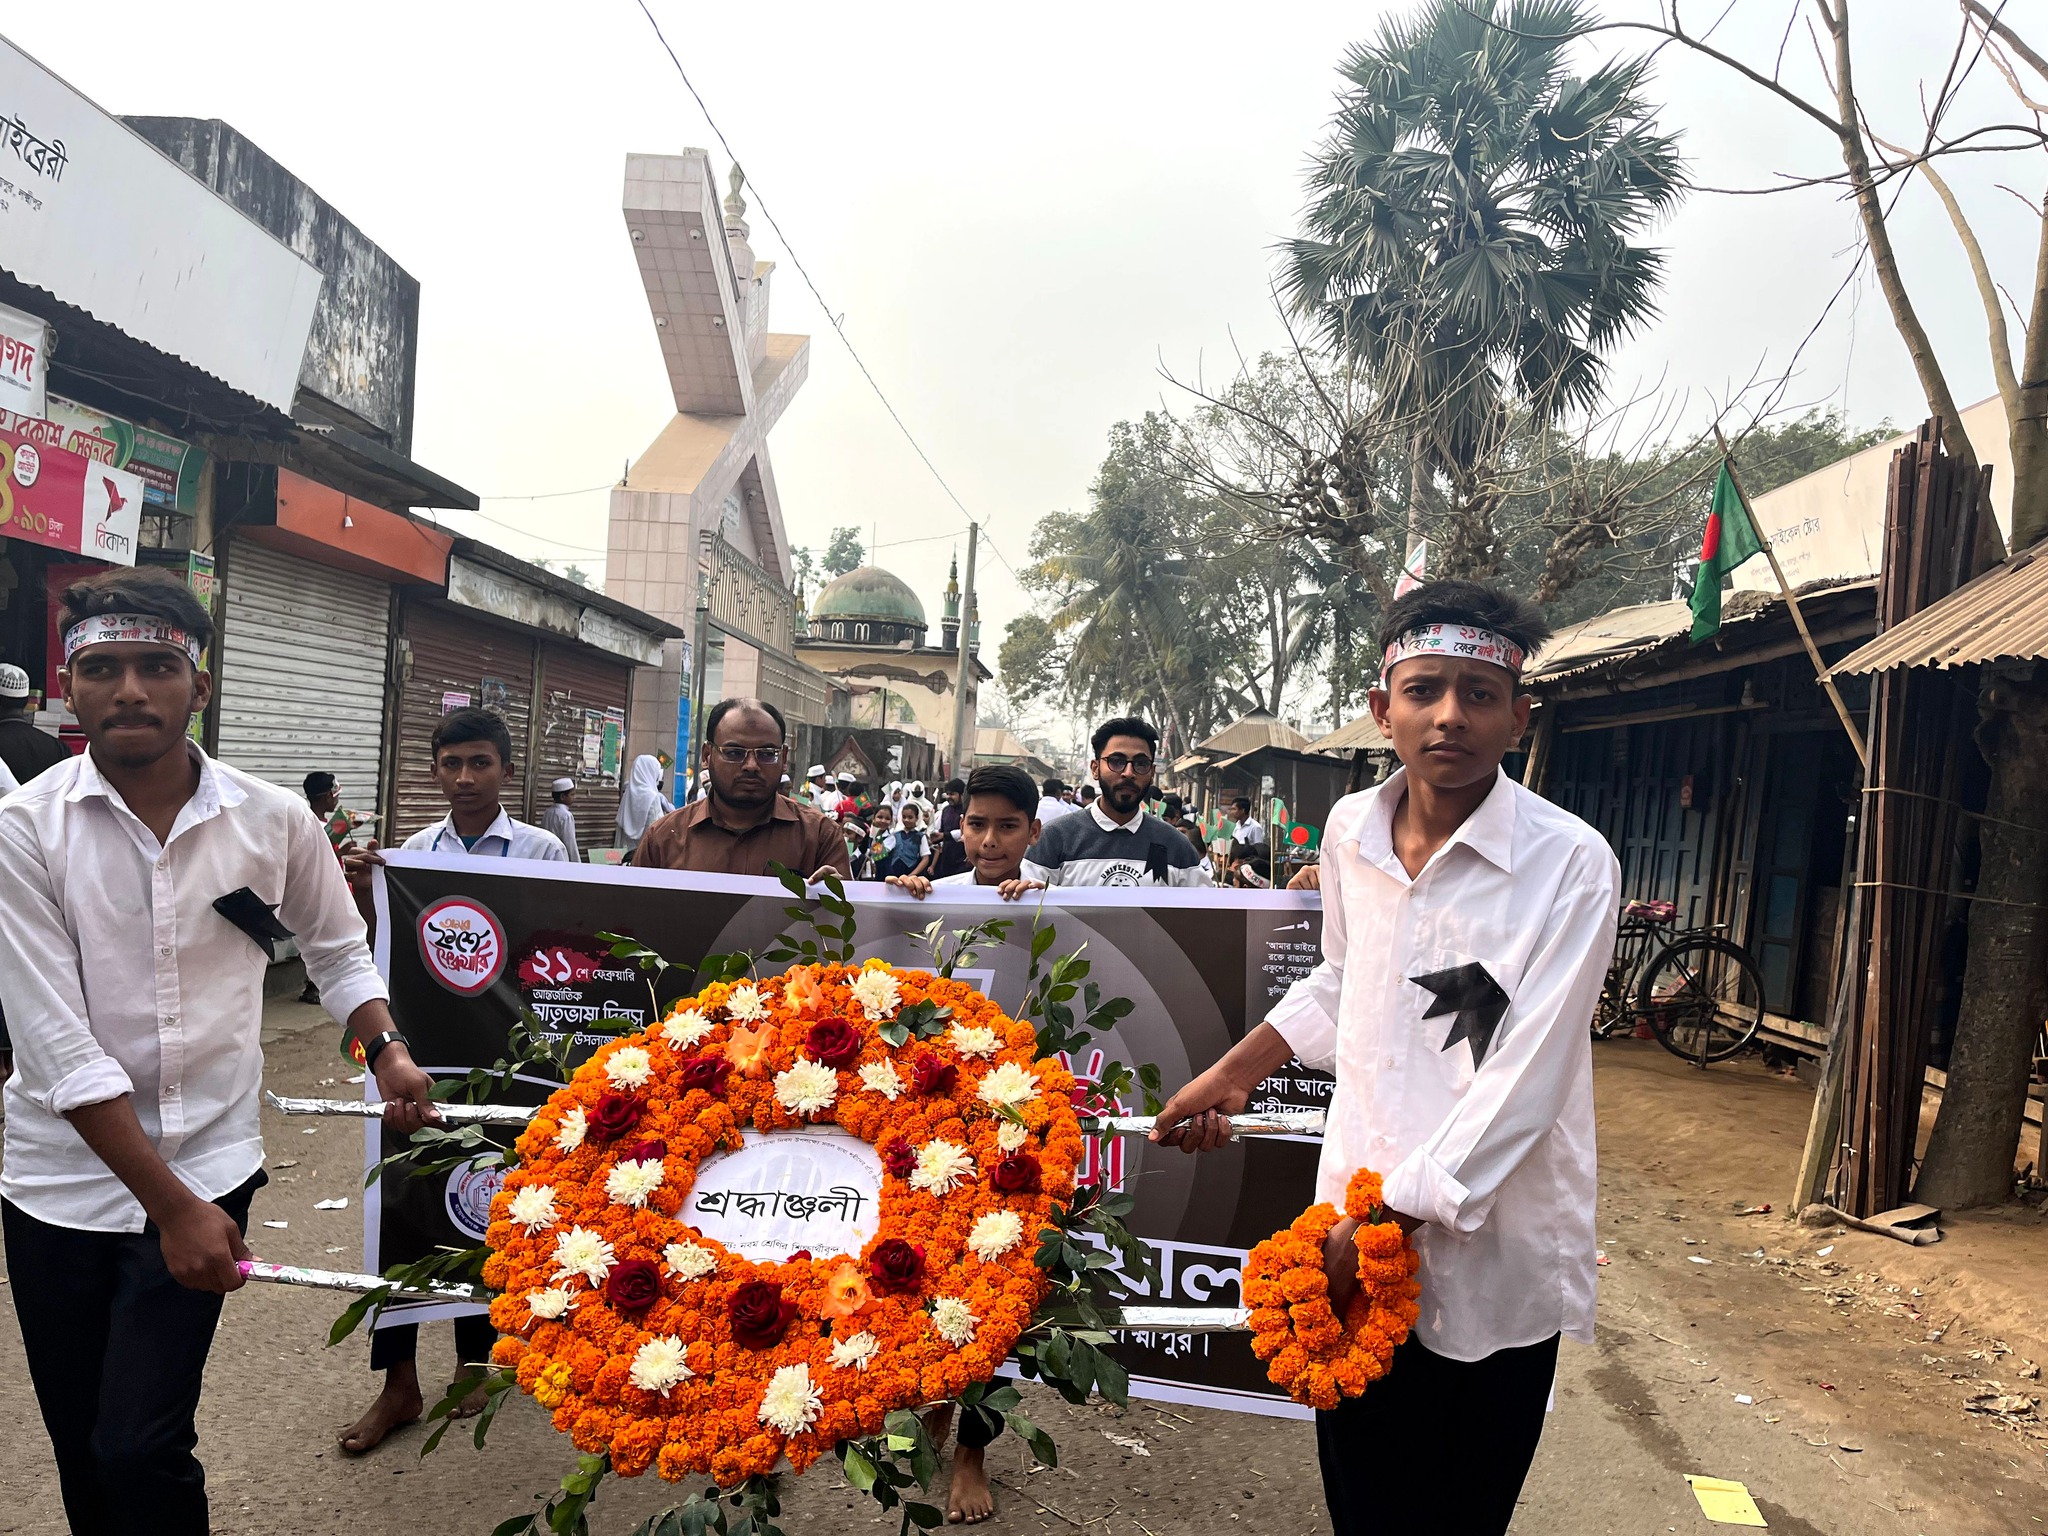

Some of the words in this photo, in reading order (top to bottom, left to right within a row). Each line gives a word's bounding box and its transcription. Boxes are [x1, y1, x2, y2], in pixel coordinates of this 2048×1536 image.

[0, 112, 69, 183] াইব্রেরী
[0, 333, 35, 382] গদ
[95, 522, 129, 555] বিকাশ
[101, 617, 117, 627] ২১
[1459, 627, 1476, 640] ২১
[1409, 638, 1443, 651] হোক
[1101, 864, 1143, 880] UNIVERSITY
[532, 950, 572, 986] ২১
[592, 967, 635, 982] ফেব্রুয়ারি
[532, 987, 583, 1001] আন্তর্জাতিক
[531, 1003, 600, 1030] মাতৃভাষা
[695, 1186, 869, 1222] শ্রদ্ধাঞ্জলী
